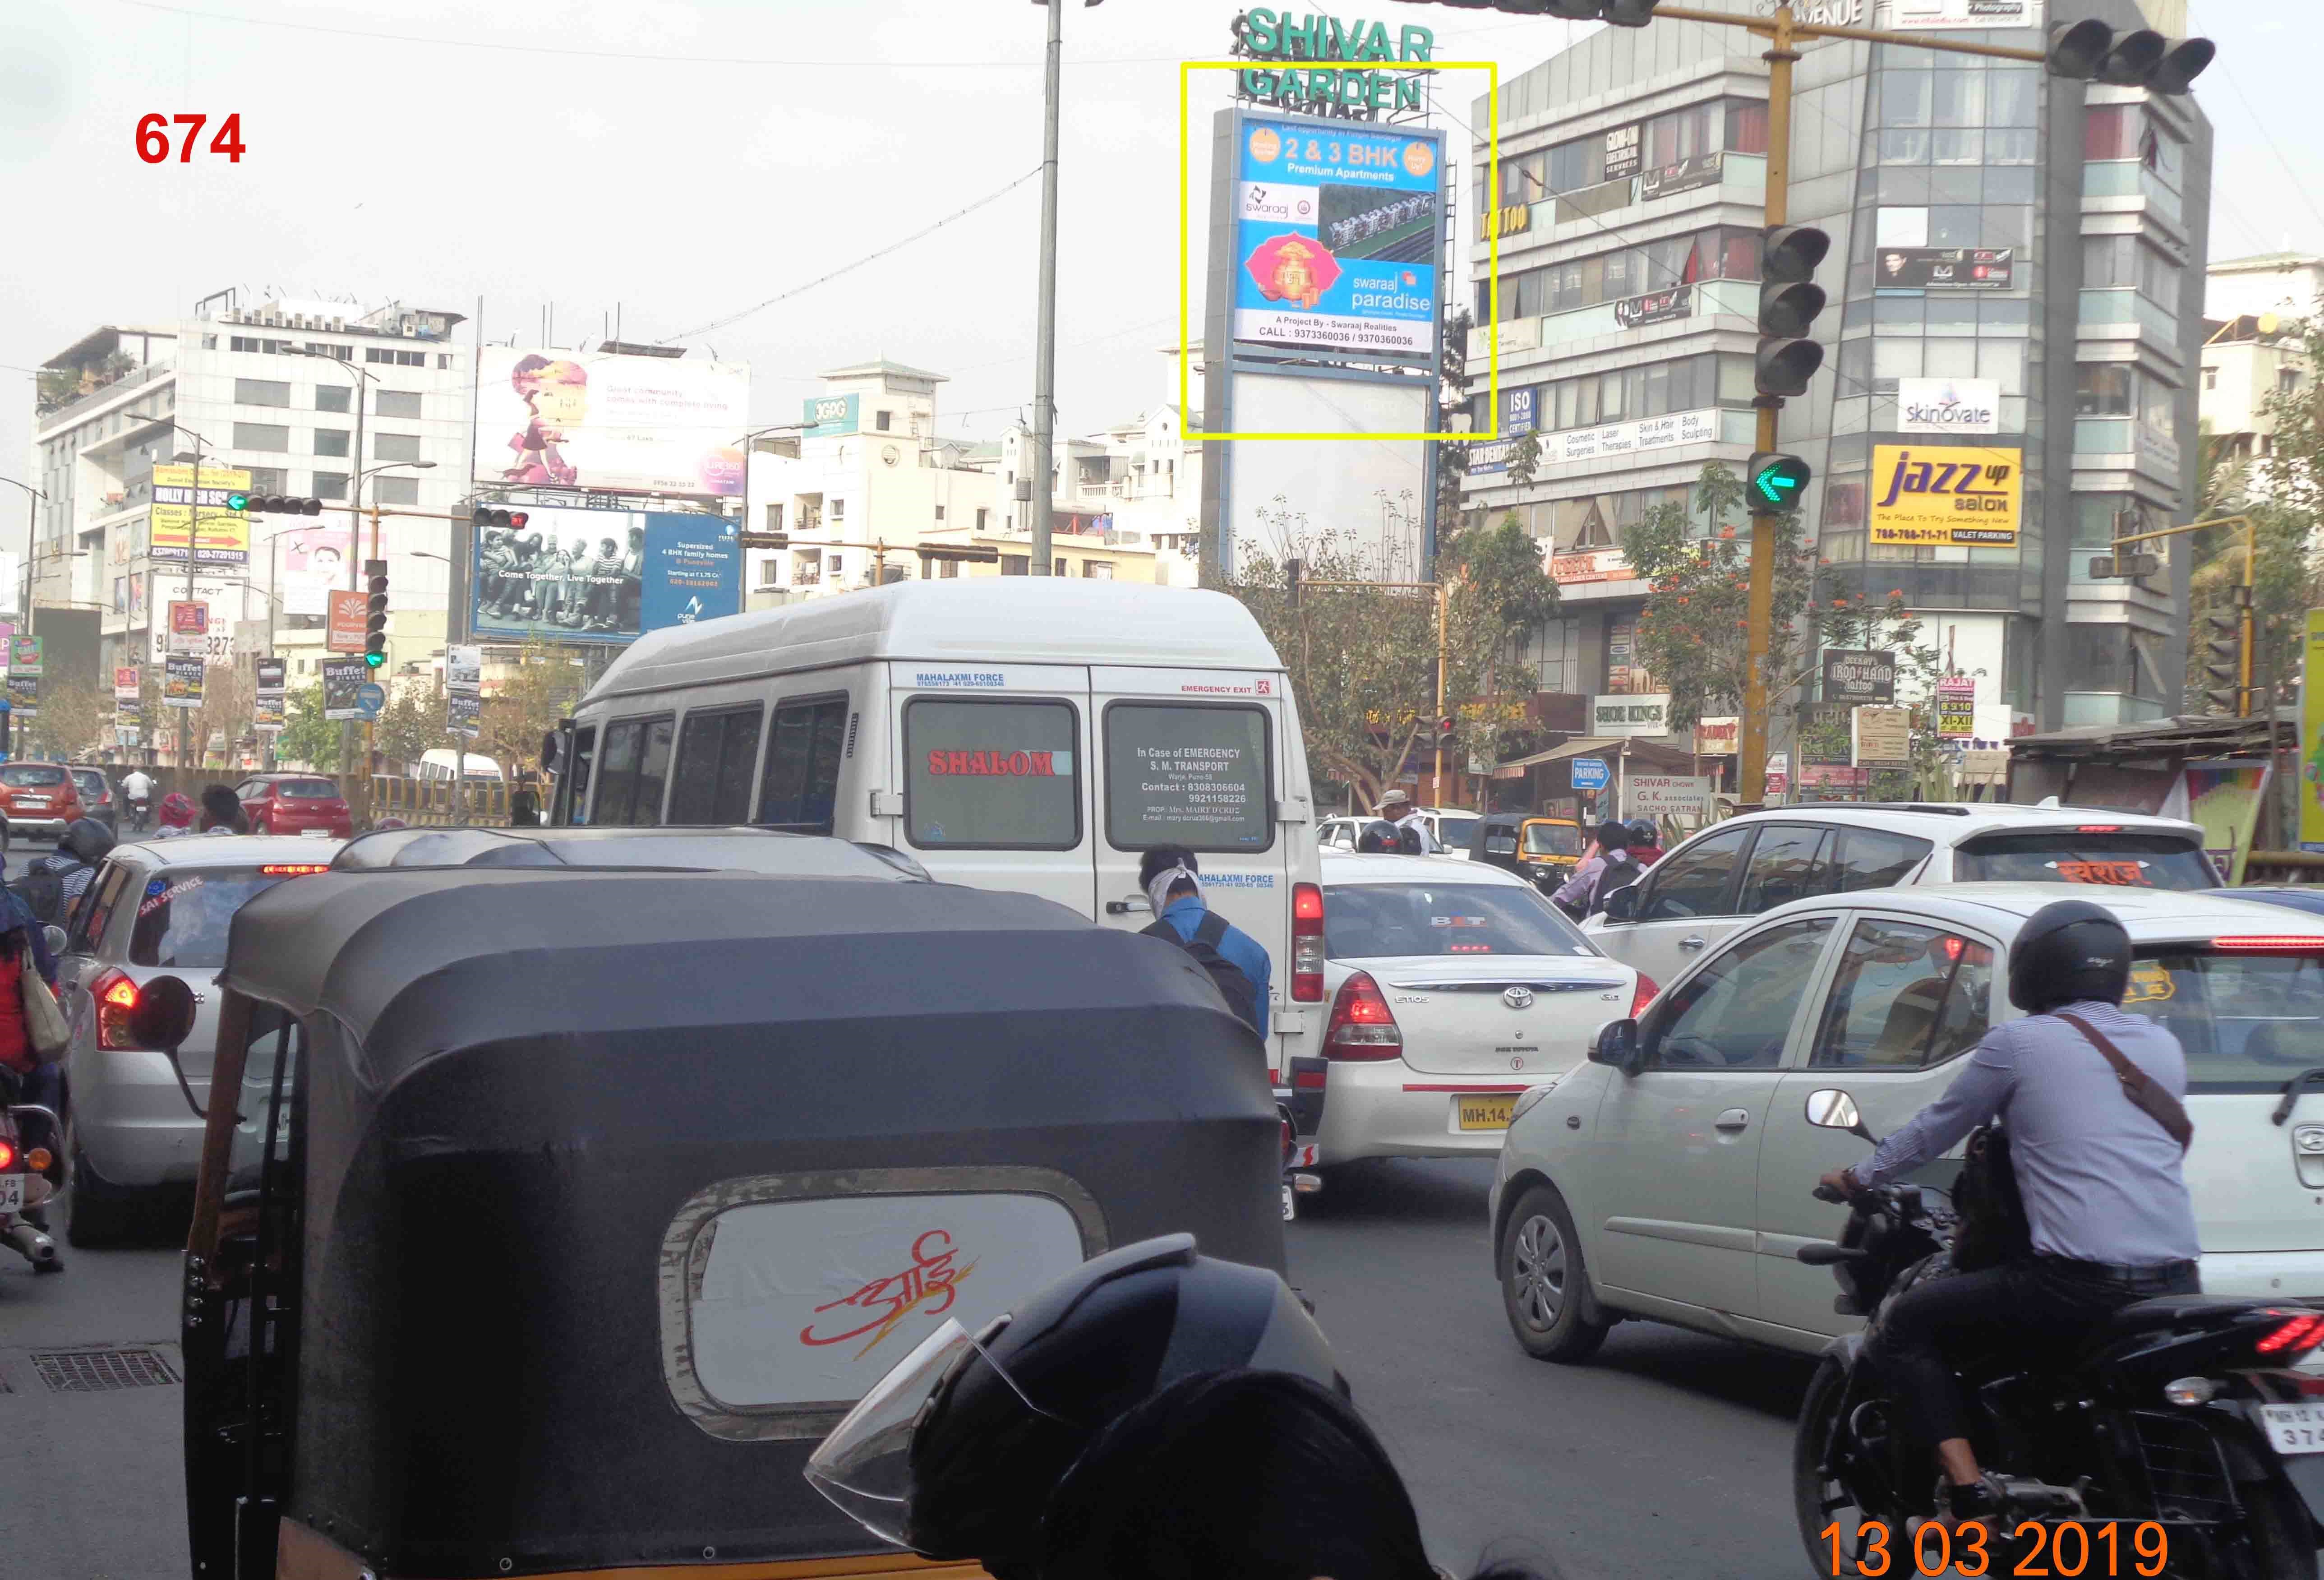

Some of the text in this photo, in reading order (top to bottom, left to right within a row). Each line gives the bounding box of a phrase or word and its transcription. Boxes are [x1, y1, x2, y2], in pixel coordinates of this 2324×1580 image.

[1244, 7, 1434, 62] SHIVAR
[1242, 68, 1421, 110] GARDEN
[1285, 139, 1298, 158] 2
[1305, 141, 1321, 161] &
[1329, 142, 1342, 162] 3
[1348, 144, 1398, 167] BHK
[1288, 162, 1394, 181] Premium Apartments
[1354, 271, 1397, 294] swaraaj
[1352, 293, 1430, 311] paradise
[1283, 317, 1311, 327] Project
[1314, 319, 1324, 328] By
[1331, 320, 1361, 332] Swaraaj
[1364, 322, 1397, 332] Realities
[1259, 327, 1286, 337] CALL
[1295, 329, 1350, 342] 9373360036
[1358, 333, 1413, 346] 9370360036
[1511, 390, 1531, 412] ISO
[1639, 419, 1675, 433] Skin & Hair
[1682, 416, 1699, 427] Body
[1567, 432, 1595, 444] Cosmetic
[1602, 429, 1619, 439] Laser
[1639, 432, 1674, 447] Treatments
[1681, 427, 1713, 440] Sculpting
[1566, 445, 1595, 457] Surgeries
[1602, 439, 1631, 452] Therapies
[1985, 464, 2010, 486] up
[156, 487, 183, 503] HOLLY
[1955, 494, 2008, 513] salon
[155, 507, 182, 517] Classes
[1877, 513, 1891, 521] The
[1930, 516, 1943, 524] Try
[1947, 516, 1989, 526] Something
[1953, 530, 2013, 541] VALET PARKING
[677, 541, 714, 550] Supersized
[684, 550, 704, 559] family
[498, 569, 624, 585] Come Together, Live Together
[667, 570, 688, 578] Starting
[173, 587, 224, 596] COTACT
[167, 662, 203, 672] Buffet
[916, 673, 1004, 681] MAHALAXMI FORCE
[1940, 678, 1974, 686] RAJAT
[1181, 685, 1231, 693] EMERGENCY
[1596, 705, 1664, 722] SHOE KINGS
[1137, 748, 1240, 758] In Case of EMERGENCY
[927, 749, 1056, 776] SHALOM
[1150, 761, 1229, 772] S. M. TRANSPORT
[1574, 767, 1604, 780] PARKING
[1141, 783, 1179, 791] Contact
[1187, 783, 1245, 792] 8308306604
[1633, 778, 1671, 788] SHIVAR
[1188, 794, 1246, 803] 9921158226
[1637, 790, 1704, 802] G. K. associates
[1245, 874, 1274, 883] FORCE
[140, 875, 204, 915] SAI SERVICE
[1396, 995, 1430, 1003] ETIOS
